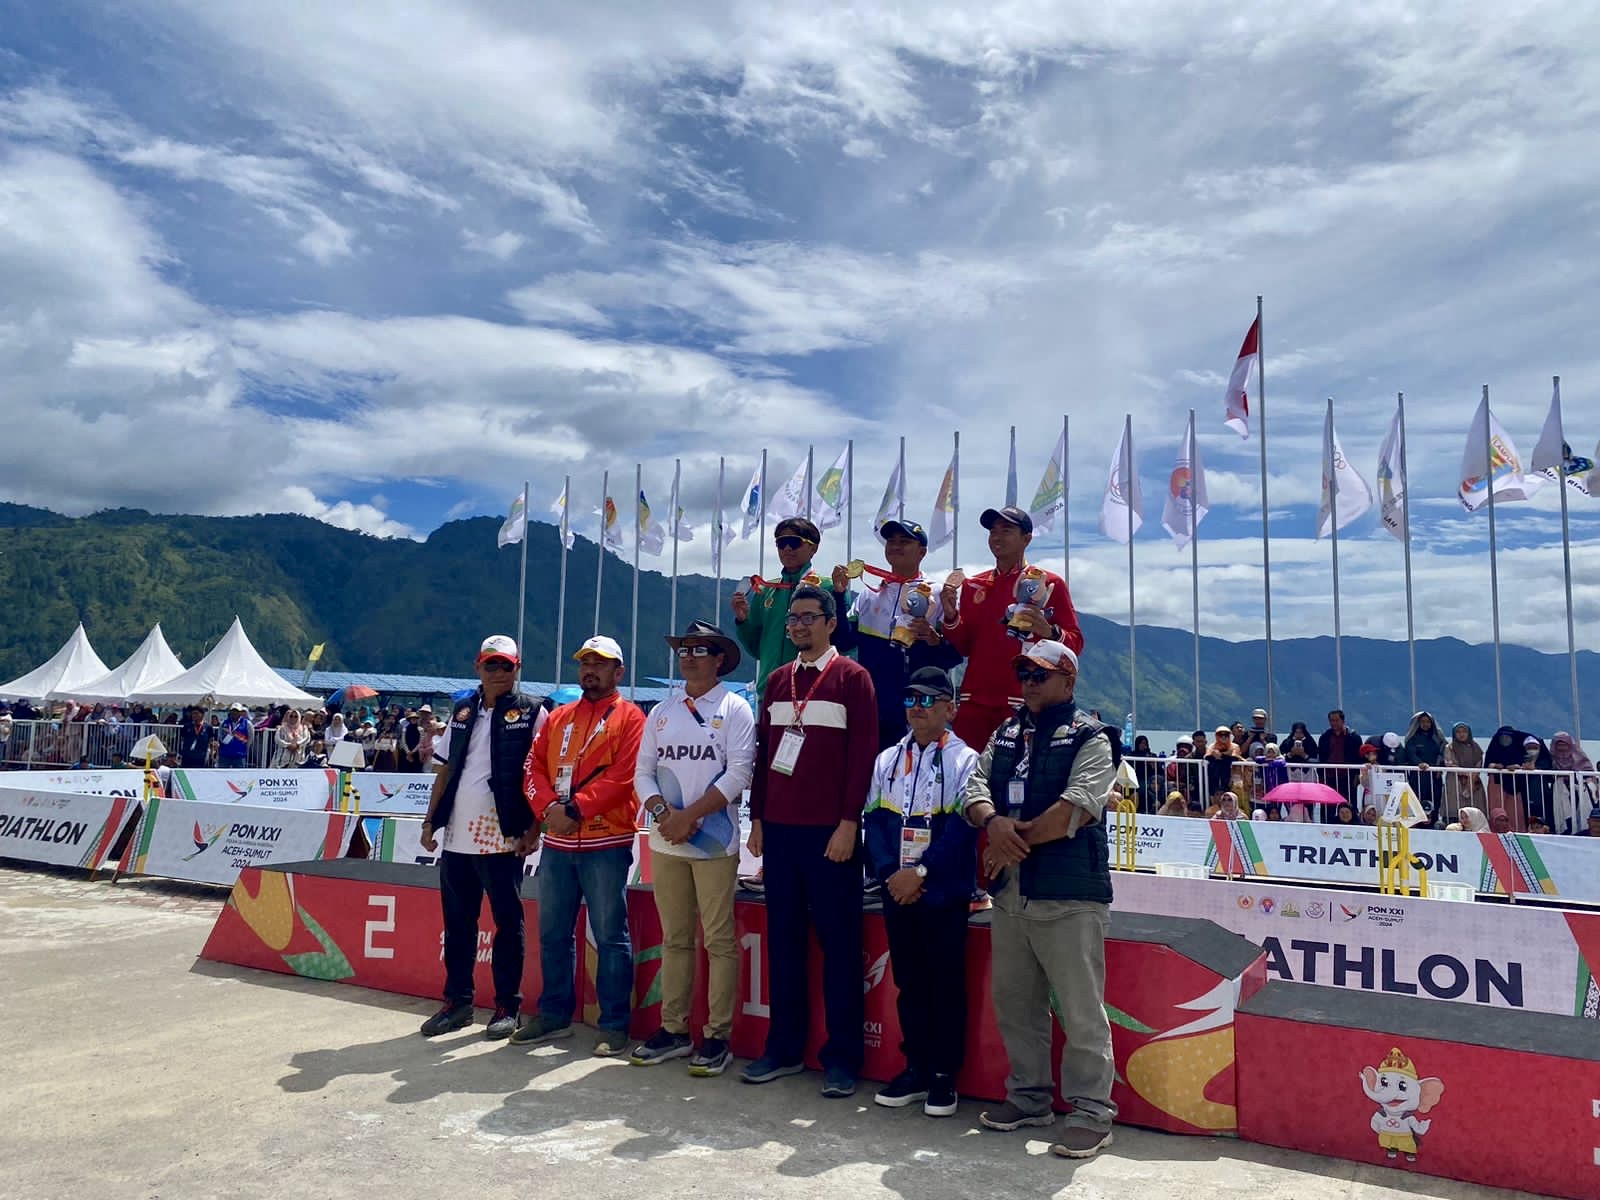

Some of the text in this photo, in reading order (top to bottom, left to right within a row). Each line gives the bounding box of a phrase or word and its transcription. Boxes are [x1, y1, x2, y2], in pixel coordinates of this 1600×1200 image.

[259, 779, 280, 787] PON
[407, 783, 429, 791] PON
[229, 823, 282, 841] PON XXI
[1141, 827, 1164, 837] XXI
[221, 846, 273, 859] ACEH-SUMUT
[1279, 844, 1459, 873] TRIATHON
[1367, 906, 1387, 914] PON
[1389, 908, 1404, 916] XXI
[1368, 915, 1404, 923] ACEH-SUMUT
[364, 895, 396, 959] 2
[740, 932, 770, 1018] 1
[1241, 934, 1524, 1007] ATHLON
